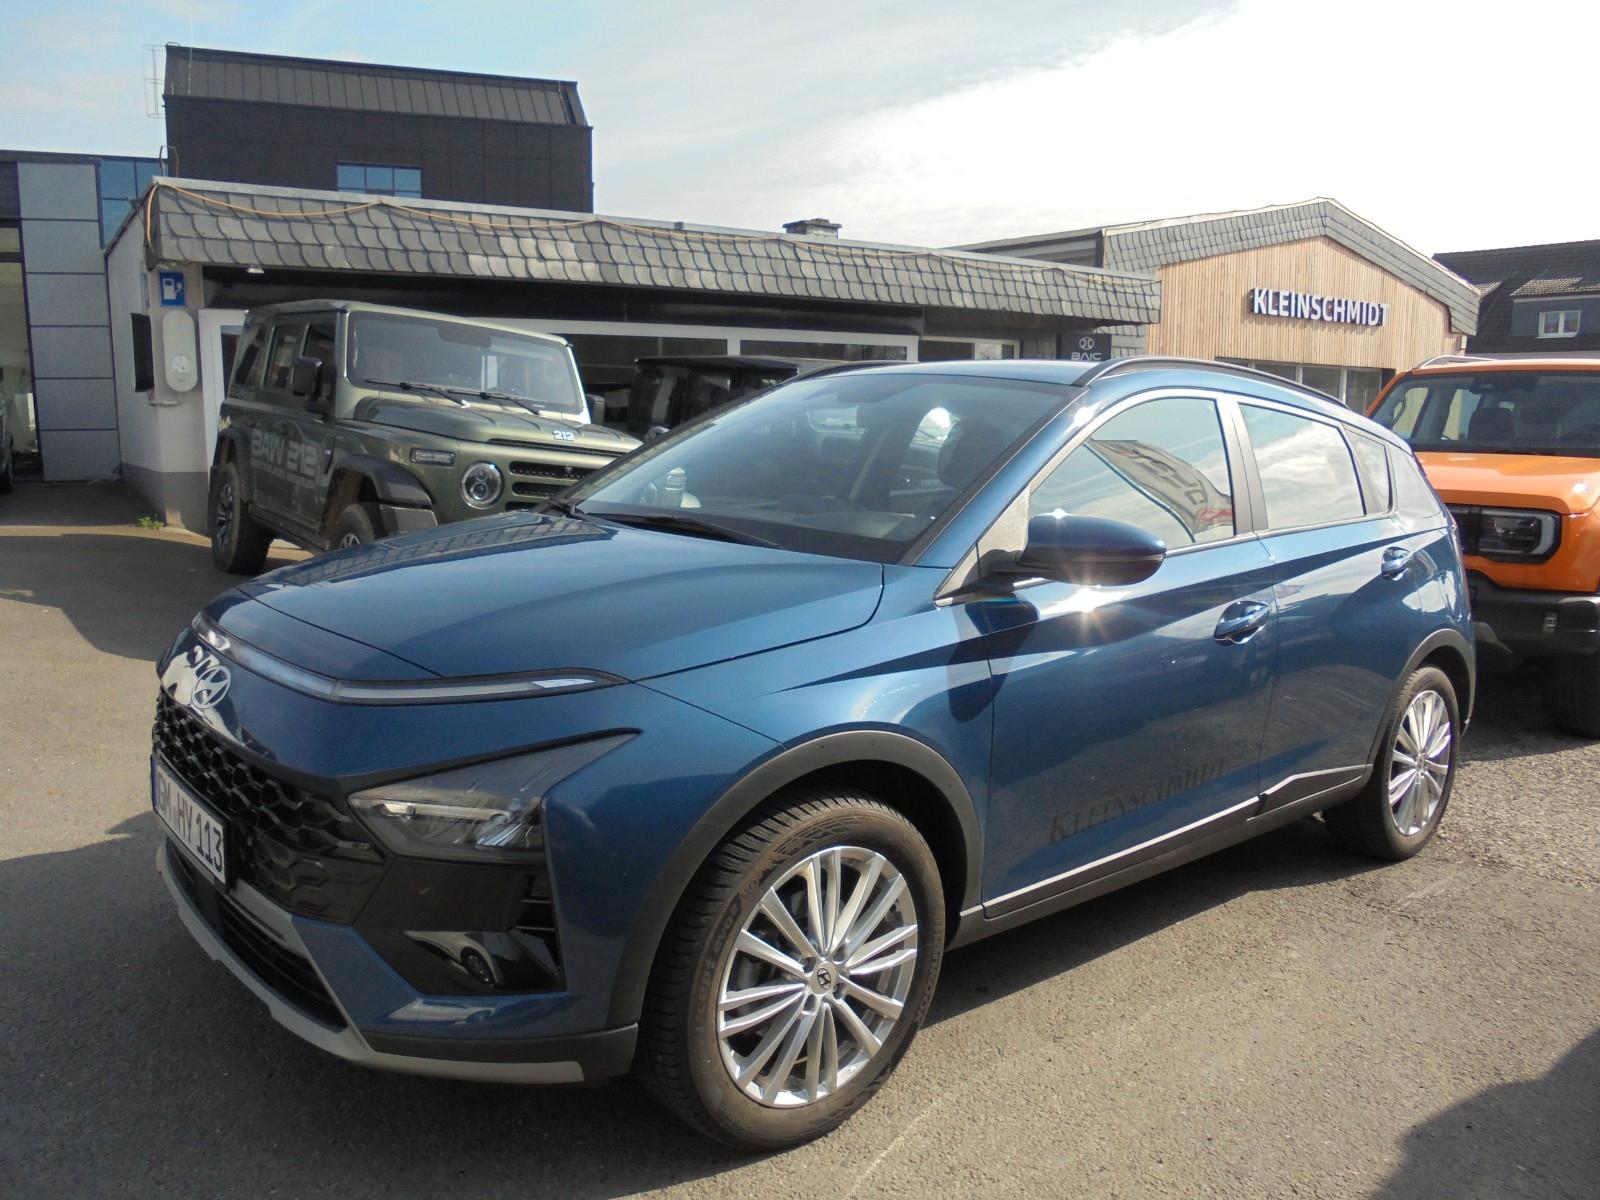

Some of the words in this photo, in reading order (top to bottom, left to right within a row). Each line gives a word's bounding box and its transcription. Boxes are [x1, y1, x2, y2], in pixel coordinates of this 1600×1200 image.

[1252, 286, 1389, 327] KLEINSCHMIDT
[552, 430, 576, 442] 212
[177, 791, 193, 844] HY
[195, 811, 223, 873] 113
